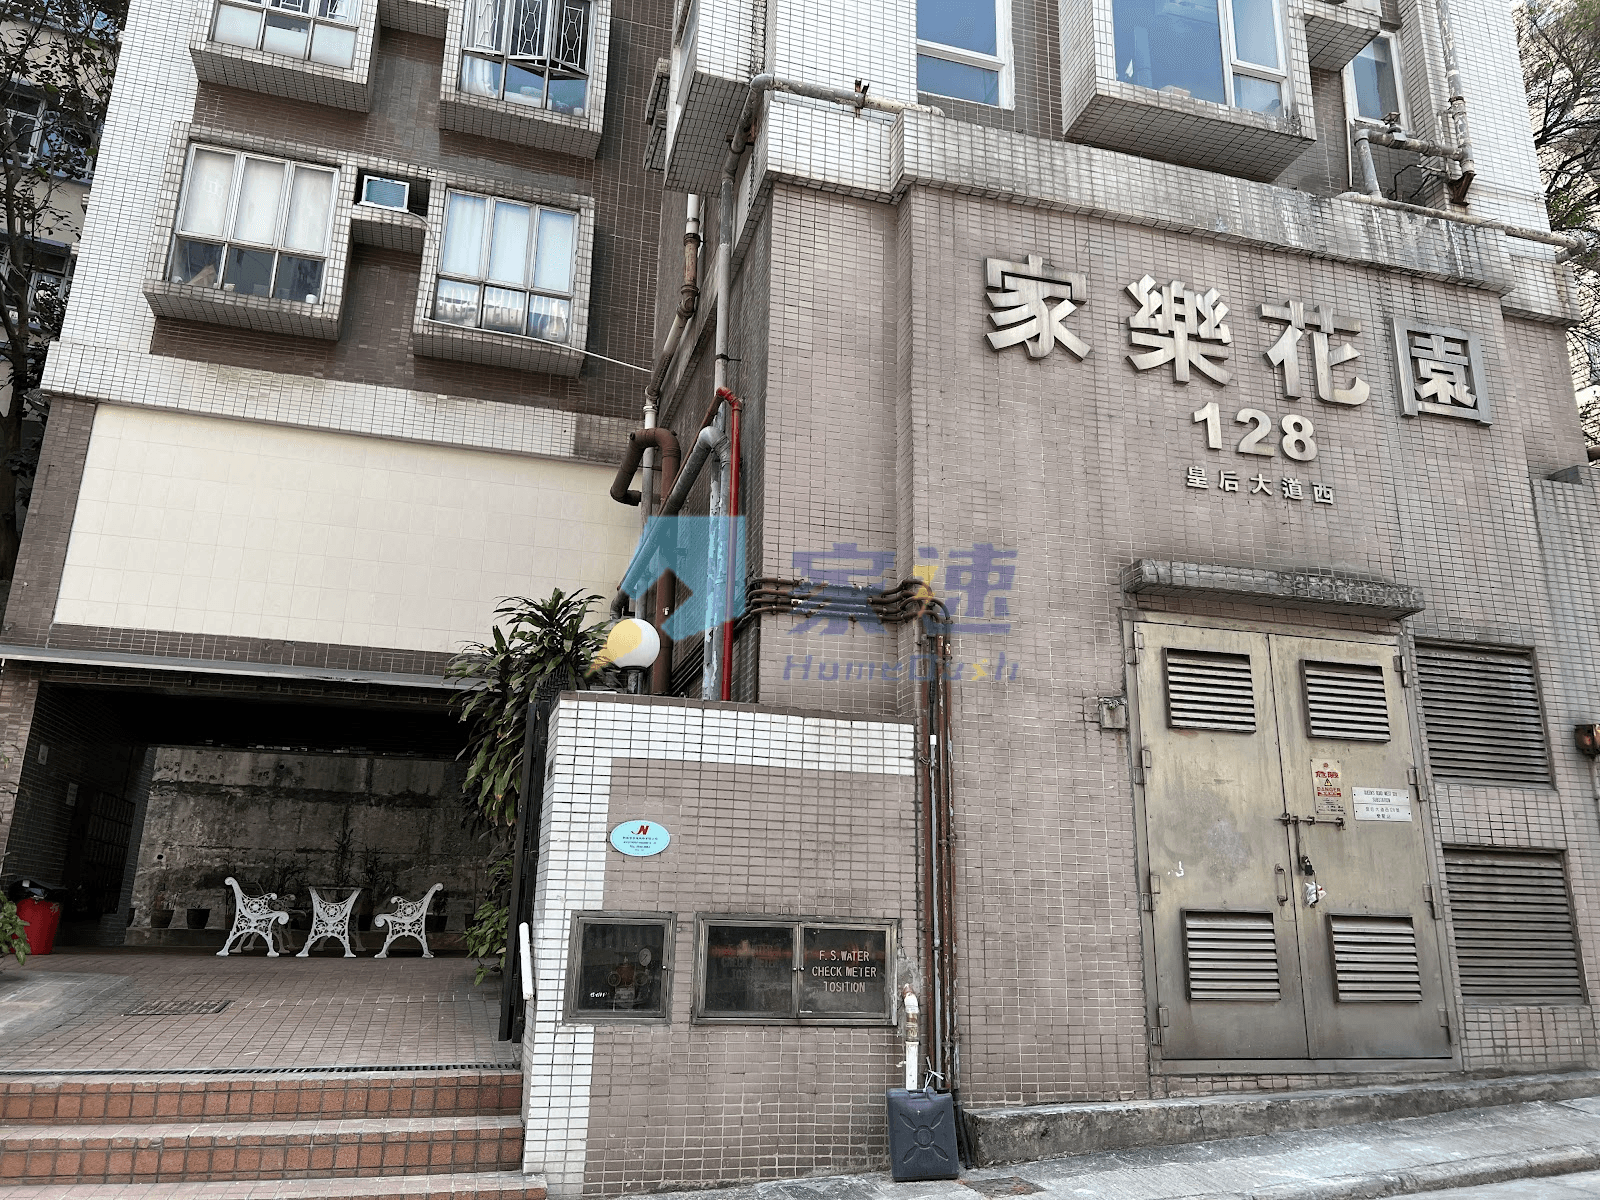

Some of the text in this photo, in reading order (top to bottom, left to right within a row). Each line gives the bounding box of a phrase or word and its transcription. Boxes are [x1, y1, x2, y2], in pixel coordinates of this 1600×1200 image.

[985, 254, 1493, 426] 家樂花園
[1192, 402, 1318, 462] 128
[1186, 466, 1335, 506] 皇后大道西
[812, 966, 877, 978] CHECK METER
